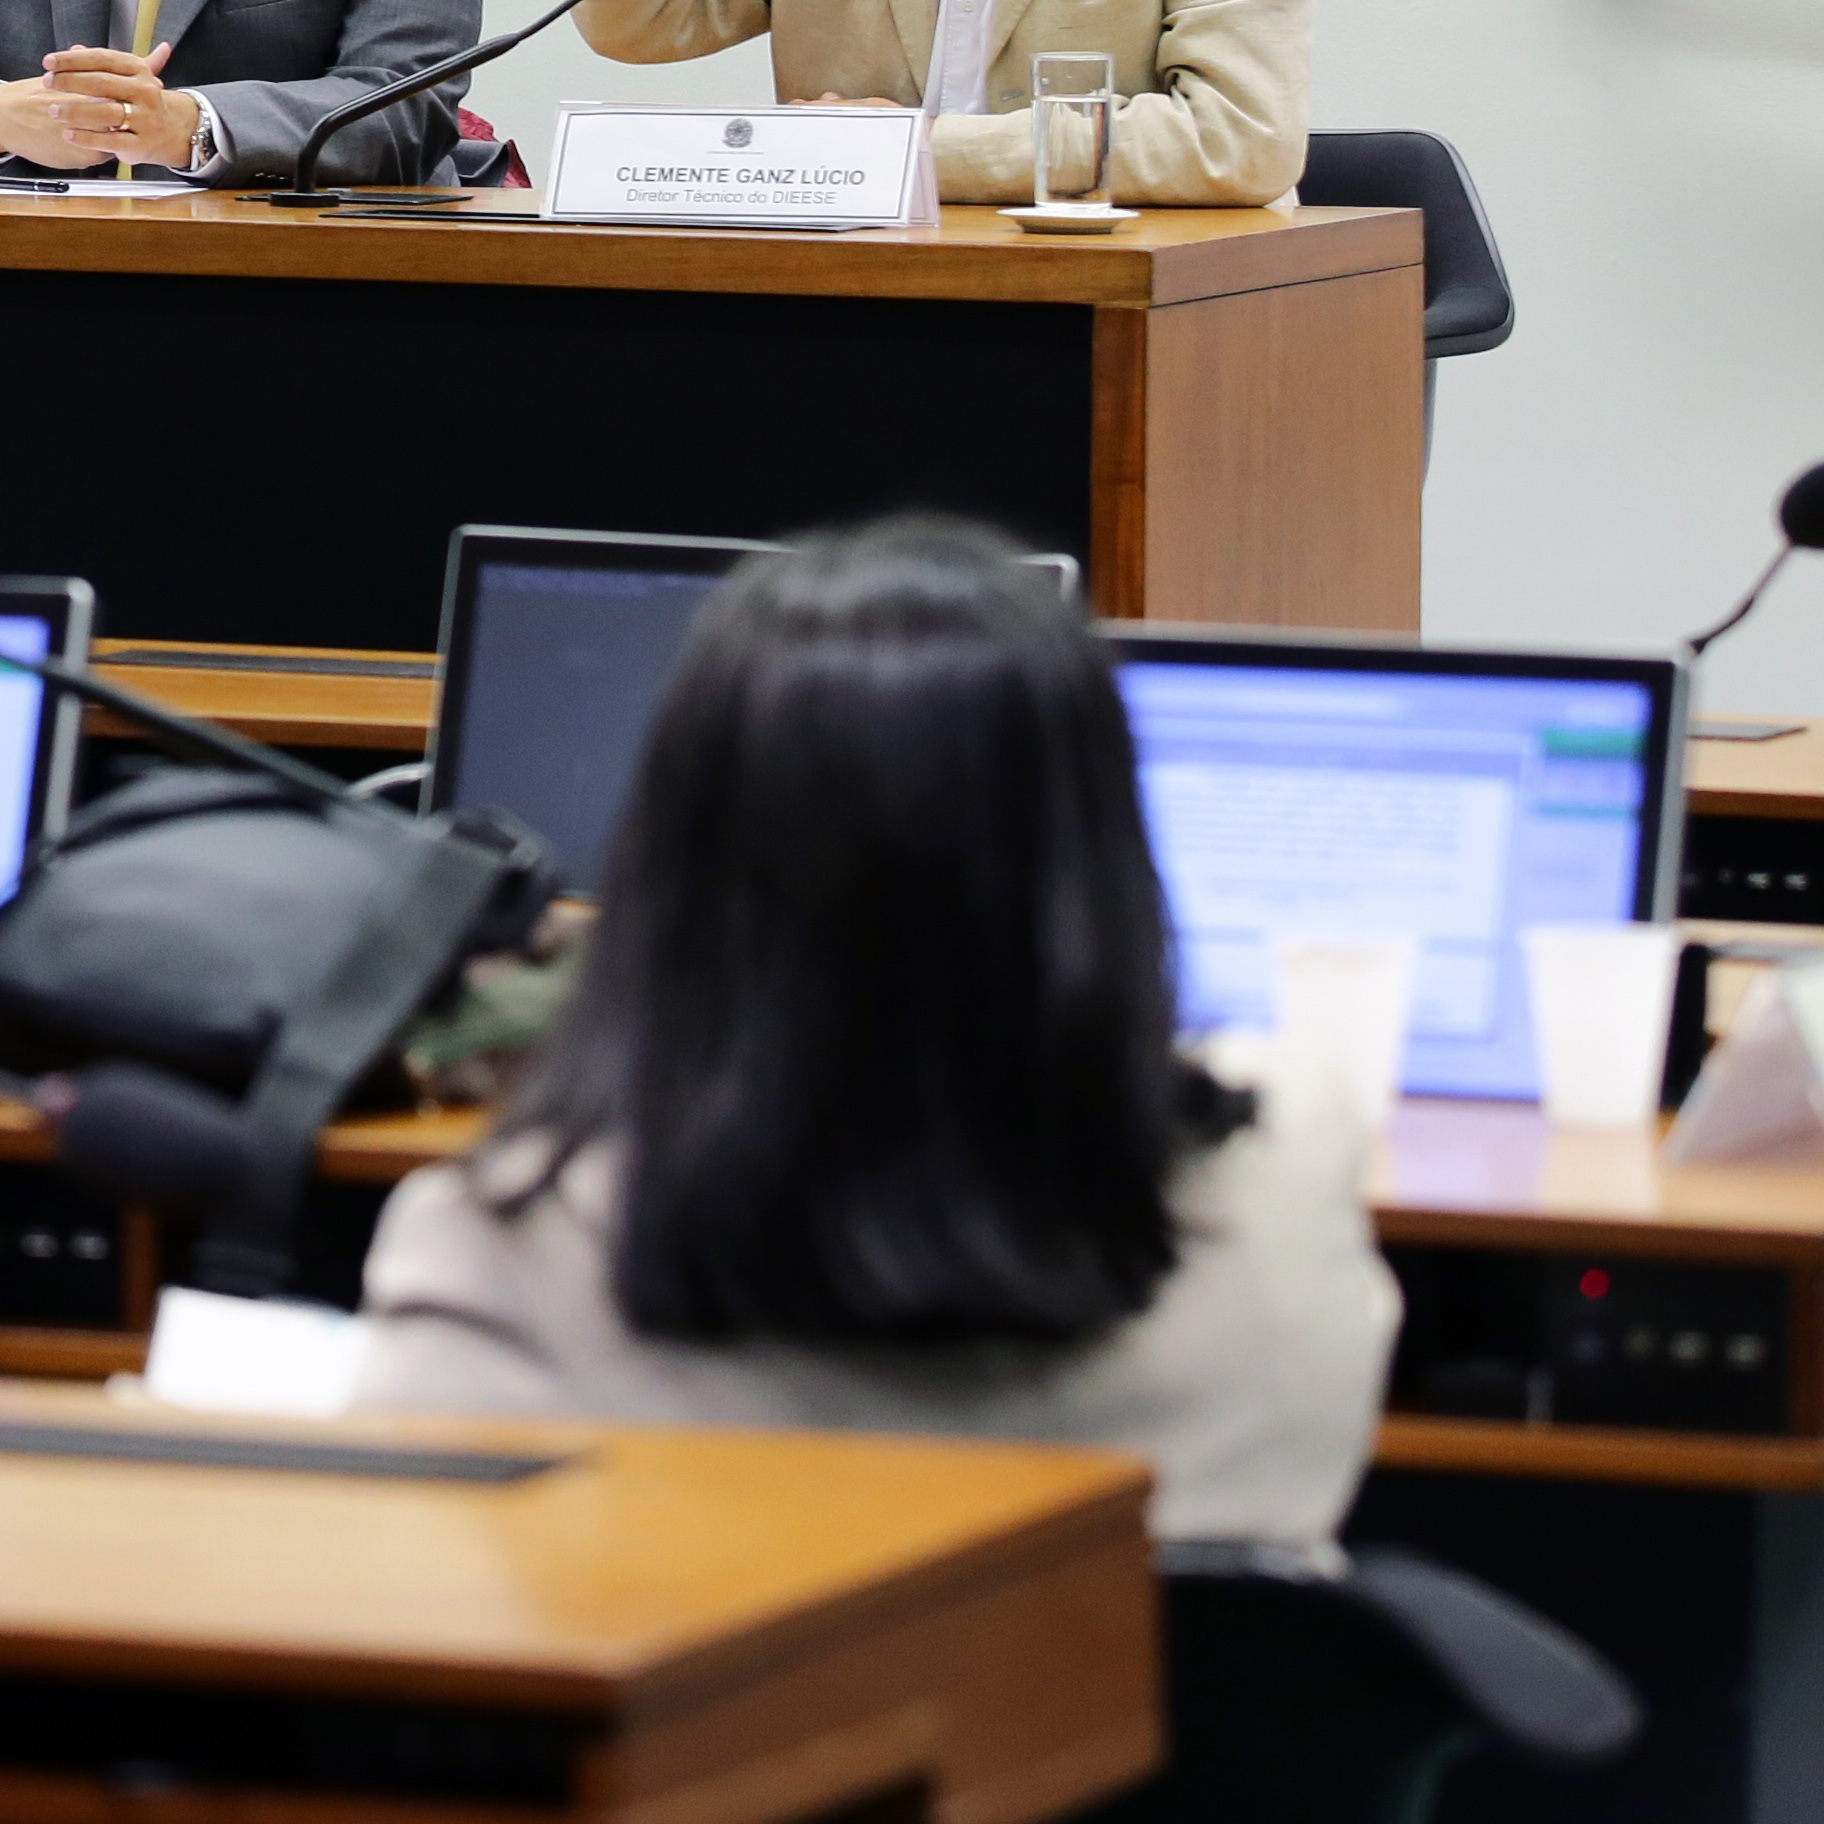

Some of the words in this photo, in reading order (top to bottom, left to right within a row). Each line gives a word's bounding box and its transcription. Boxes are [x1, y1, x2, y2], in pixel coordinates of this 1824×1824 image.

[615, 167, 731, 184] CLEMENTE
[736, 168, 797, 185] GANZ
[800, 165, 867, 186] LÚCIO
[626, 188, 679, 203] Diretor
[683, 188, 743, 204] Técnico
[772, 190, 838, 205] DIEESE
